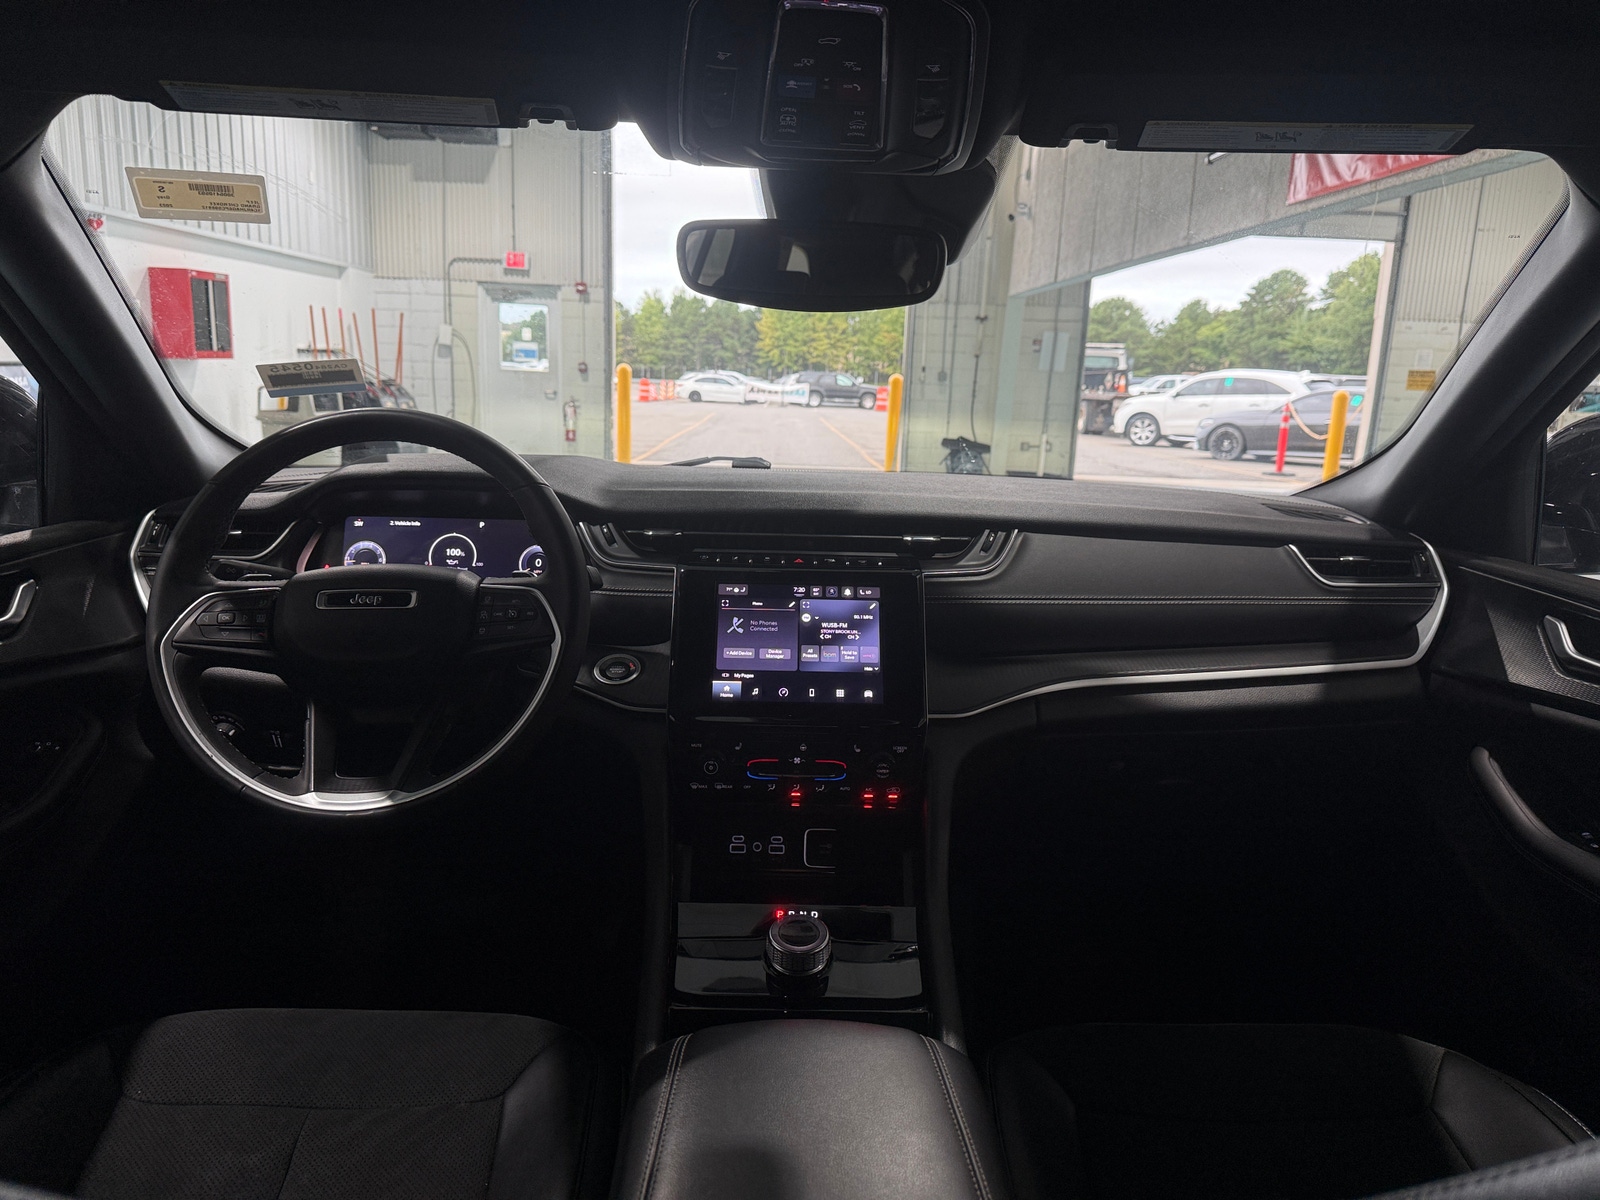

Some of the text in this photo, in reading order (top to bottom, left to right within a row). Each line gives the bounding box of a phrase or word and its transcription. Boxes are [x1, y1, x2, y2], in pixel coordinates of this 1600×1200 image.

[535, 558, 542, 567] 0
[349, 592, 382, 606] Jeep
[823, 651, 837, 659] bpm
[776, 910, 784, 918] P
